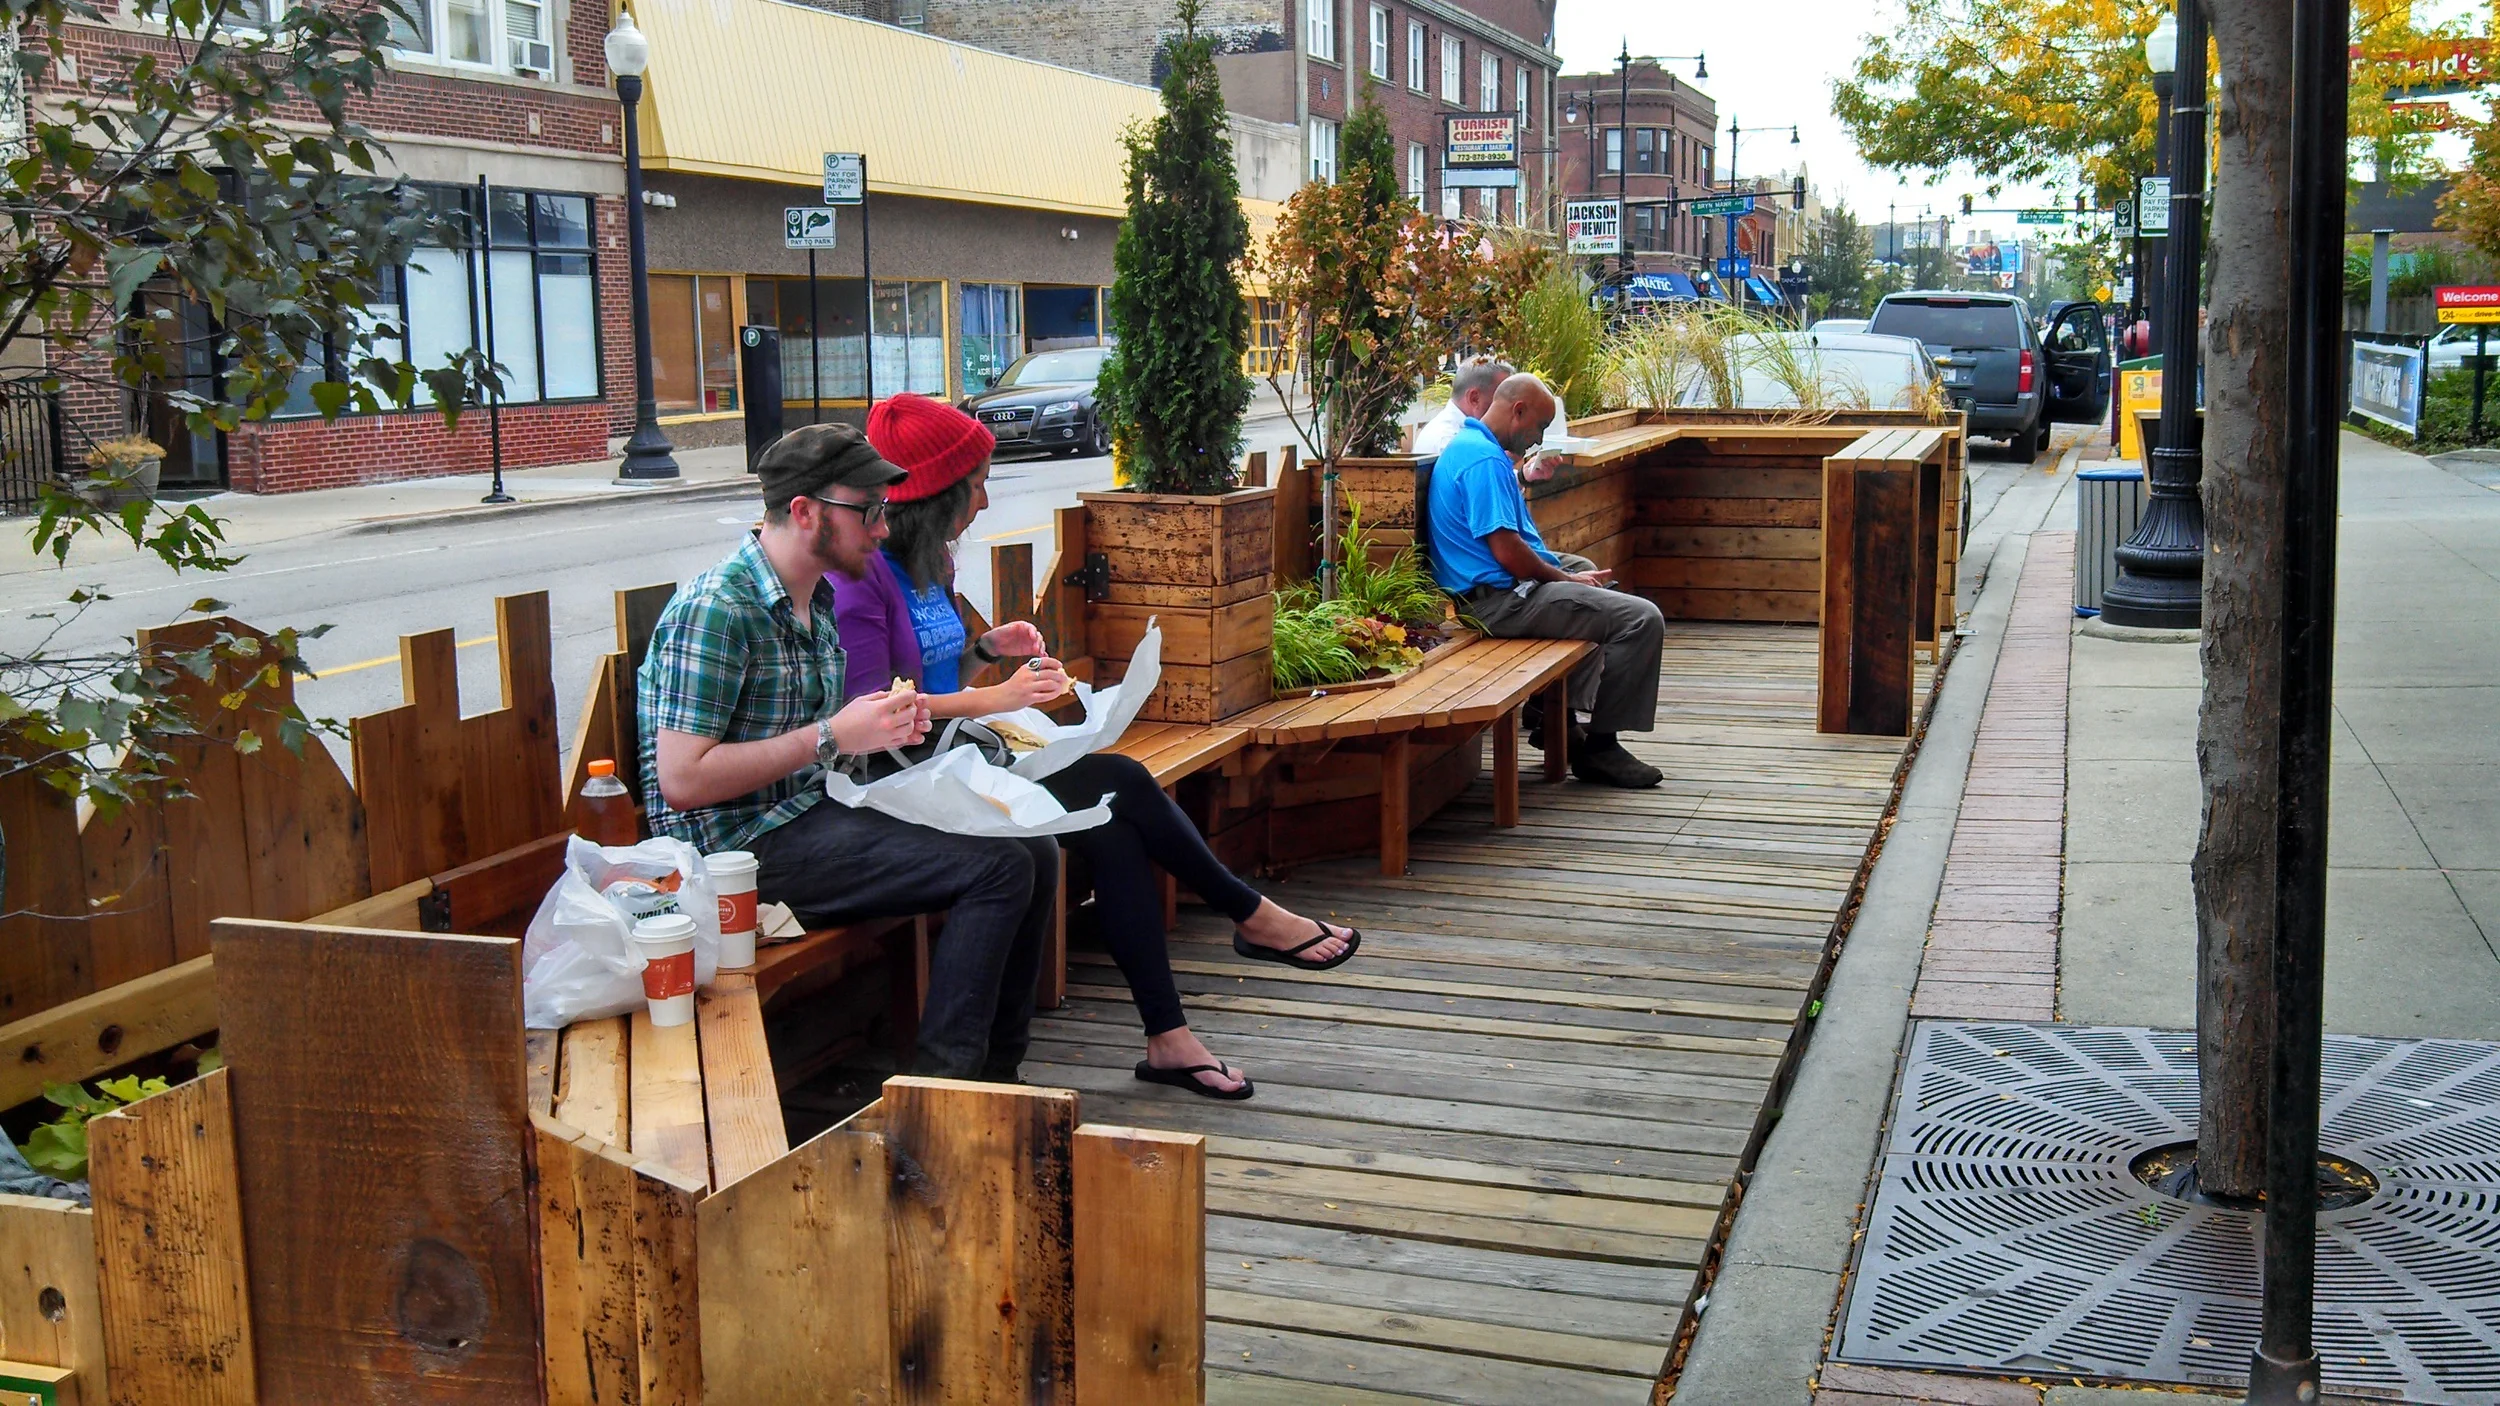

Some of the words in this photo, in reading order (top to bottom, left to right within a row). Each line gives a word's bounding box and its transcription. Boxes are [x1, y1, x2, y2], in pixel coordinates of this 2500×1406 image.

[1453, 119, 1508, 130] TURKISH
[1453, 130, 1503, 141] CUISINE
[1568, 204, 1617, 220] JACKSON
[1581, 221, 1617, 236] HEWITT
[1590, 241, 1614, 249] SERVICE
[2442, 291, 2499, 302] Welcome
[2442, 311, 2455, 320] 24
